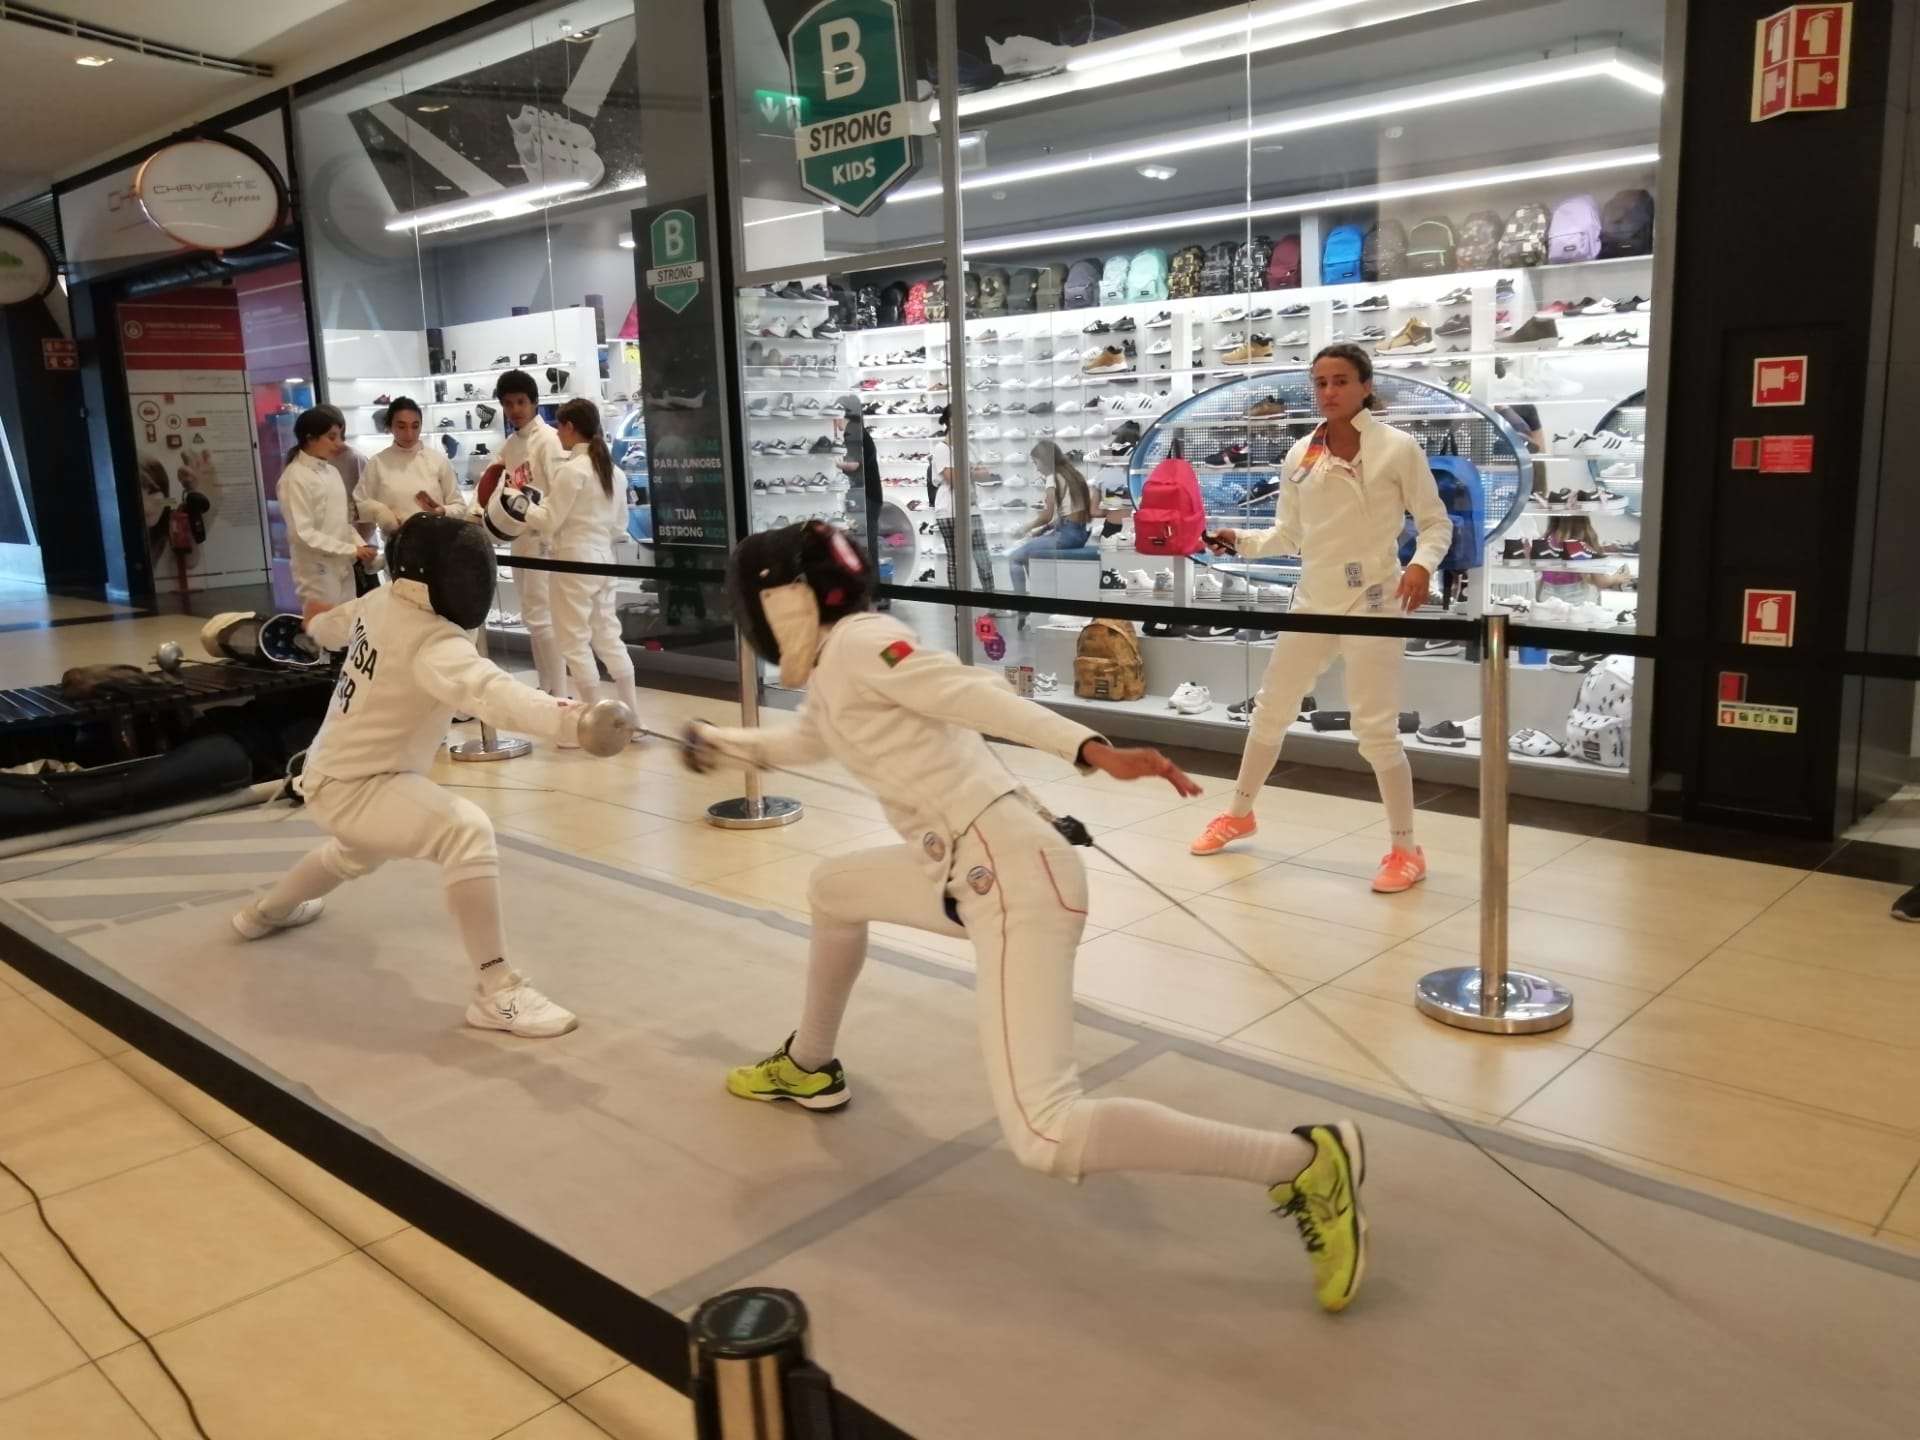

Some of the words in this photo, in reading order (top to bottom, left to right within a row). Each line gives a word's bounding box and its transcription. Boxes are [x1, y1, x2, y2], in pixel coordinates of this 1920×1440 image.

[819, 17, 867, 101] B
[810, 110, 892, 152] STRONG
[832, 158, 876, 186] KIDS
[211, 191, 261, 207] Express
[664, 219, 684, 257] B
[657, 266, 693, 282] STRONG
[653, 458, 679, 469] PARA
[680, 458, 722, 469] JUNIORES
[675, 507, 697, 520] TUA
[659, 525, 704, 538] BSTRONG
